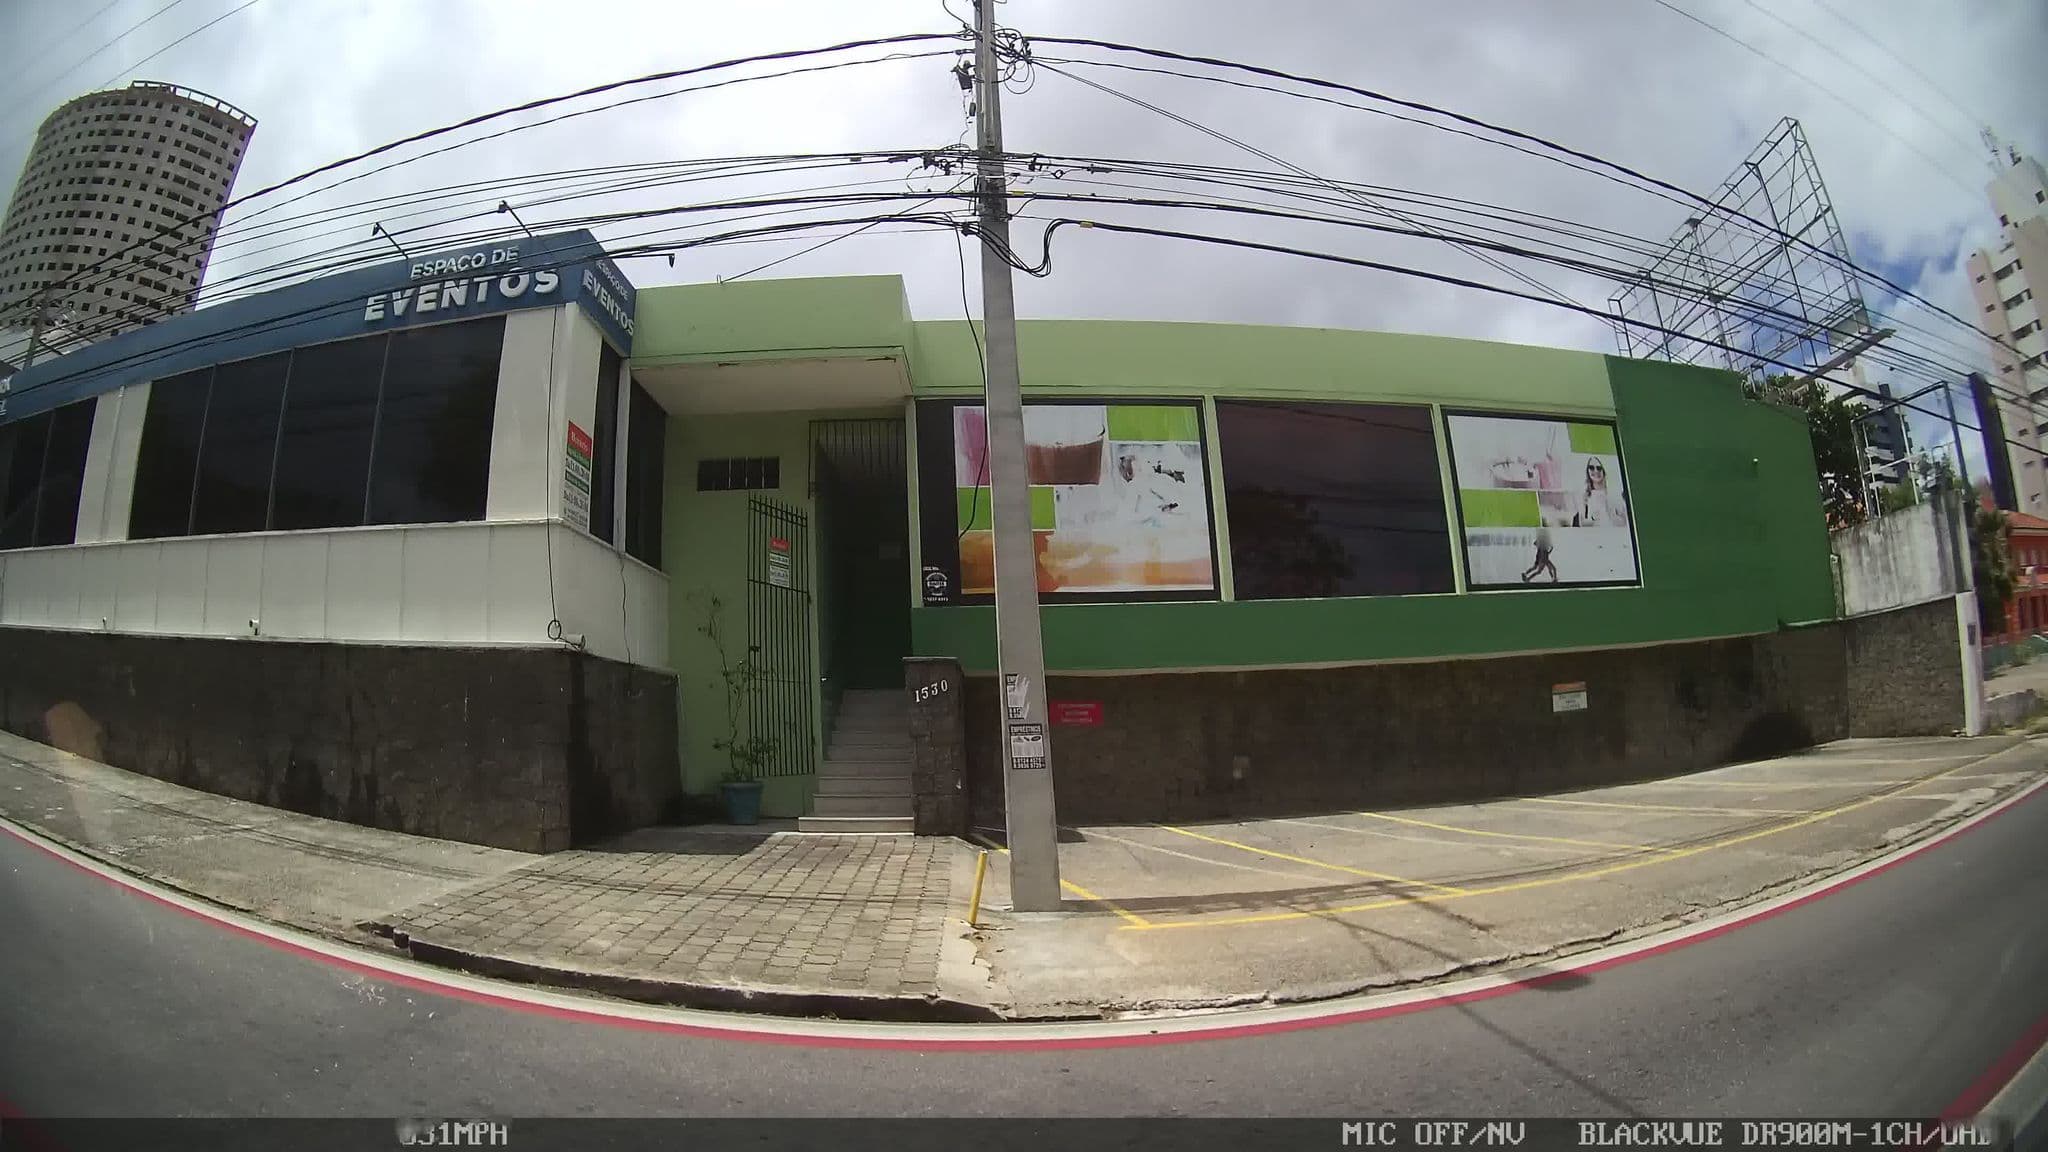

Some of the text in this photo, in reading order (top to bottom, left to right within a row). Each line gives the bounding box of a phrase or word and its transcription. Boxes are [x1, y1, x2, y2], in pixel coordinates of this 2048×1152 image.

[491, 246, 519, 264] DE
[364, 267, 560, 321] EVENTOS
[583, 268, 634, 336] EVENTOS
[915, 680, 948, 702] 1530
